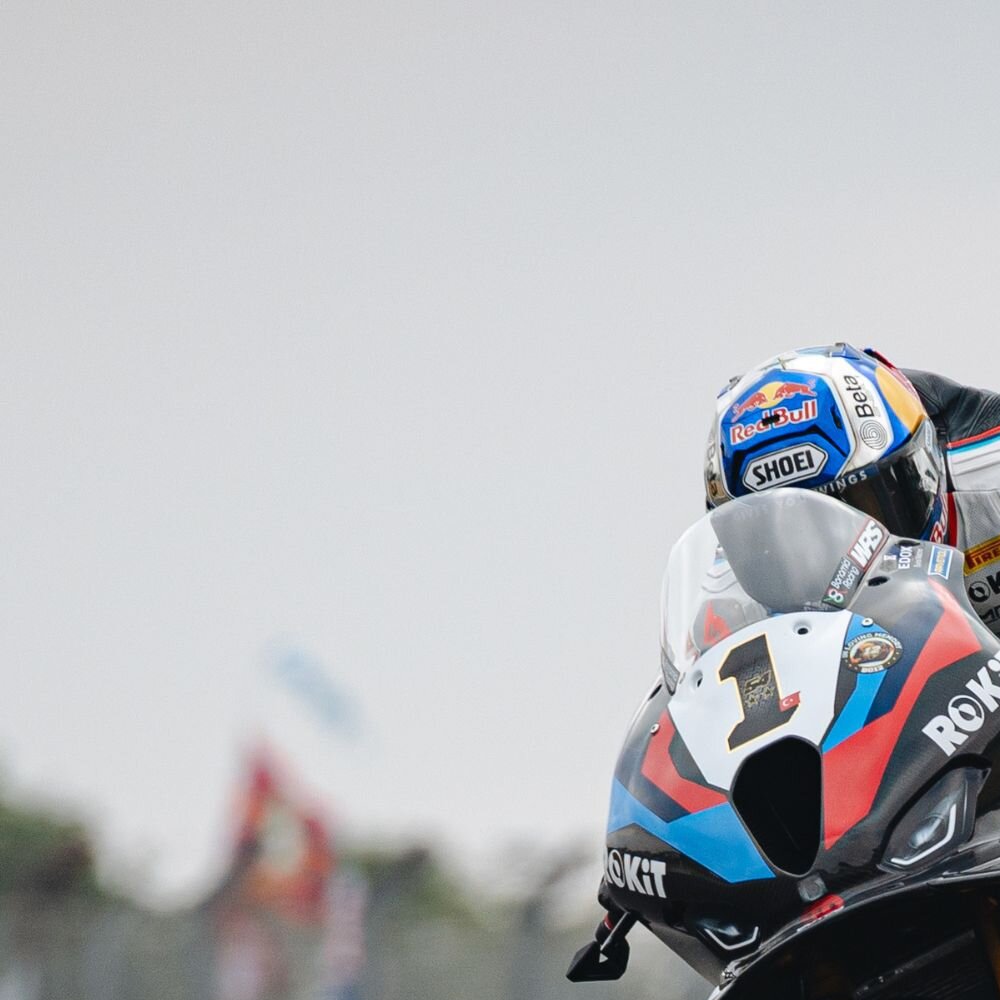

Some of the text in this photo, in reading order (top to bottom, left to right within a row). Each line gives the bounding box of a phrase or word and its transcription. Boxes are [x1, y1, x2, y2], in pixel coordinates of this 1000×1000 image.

[842, 374, 875, 419] Beta
[730, 399, 818, 445] Red Bull
[752, 450, 815, 486] SHOEI
[898, 546, 913, 569] EDOX
[717, 633, 800, 752] 1
